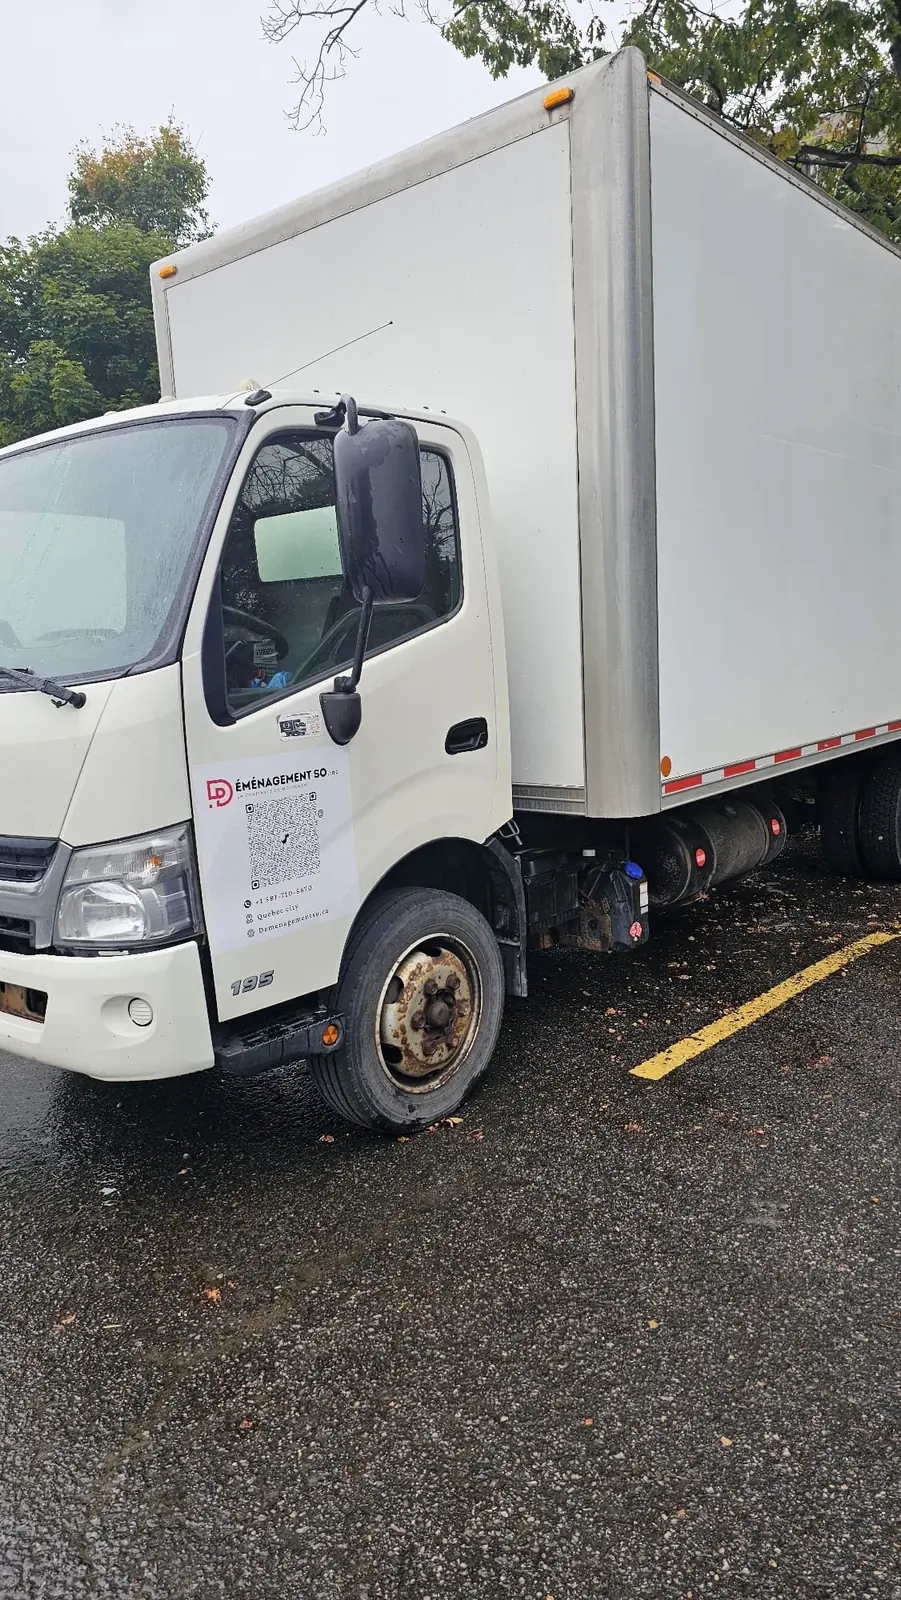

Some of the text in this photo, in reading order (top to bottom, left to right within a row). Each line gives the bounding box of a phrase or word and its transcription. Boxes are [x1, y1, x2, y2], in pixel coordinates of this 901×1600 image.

[257, 903, 300, 921] Quebec city
[231, 969, 275, 996] 195
